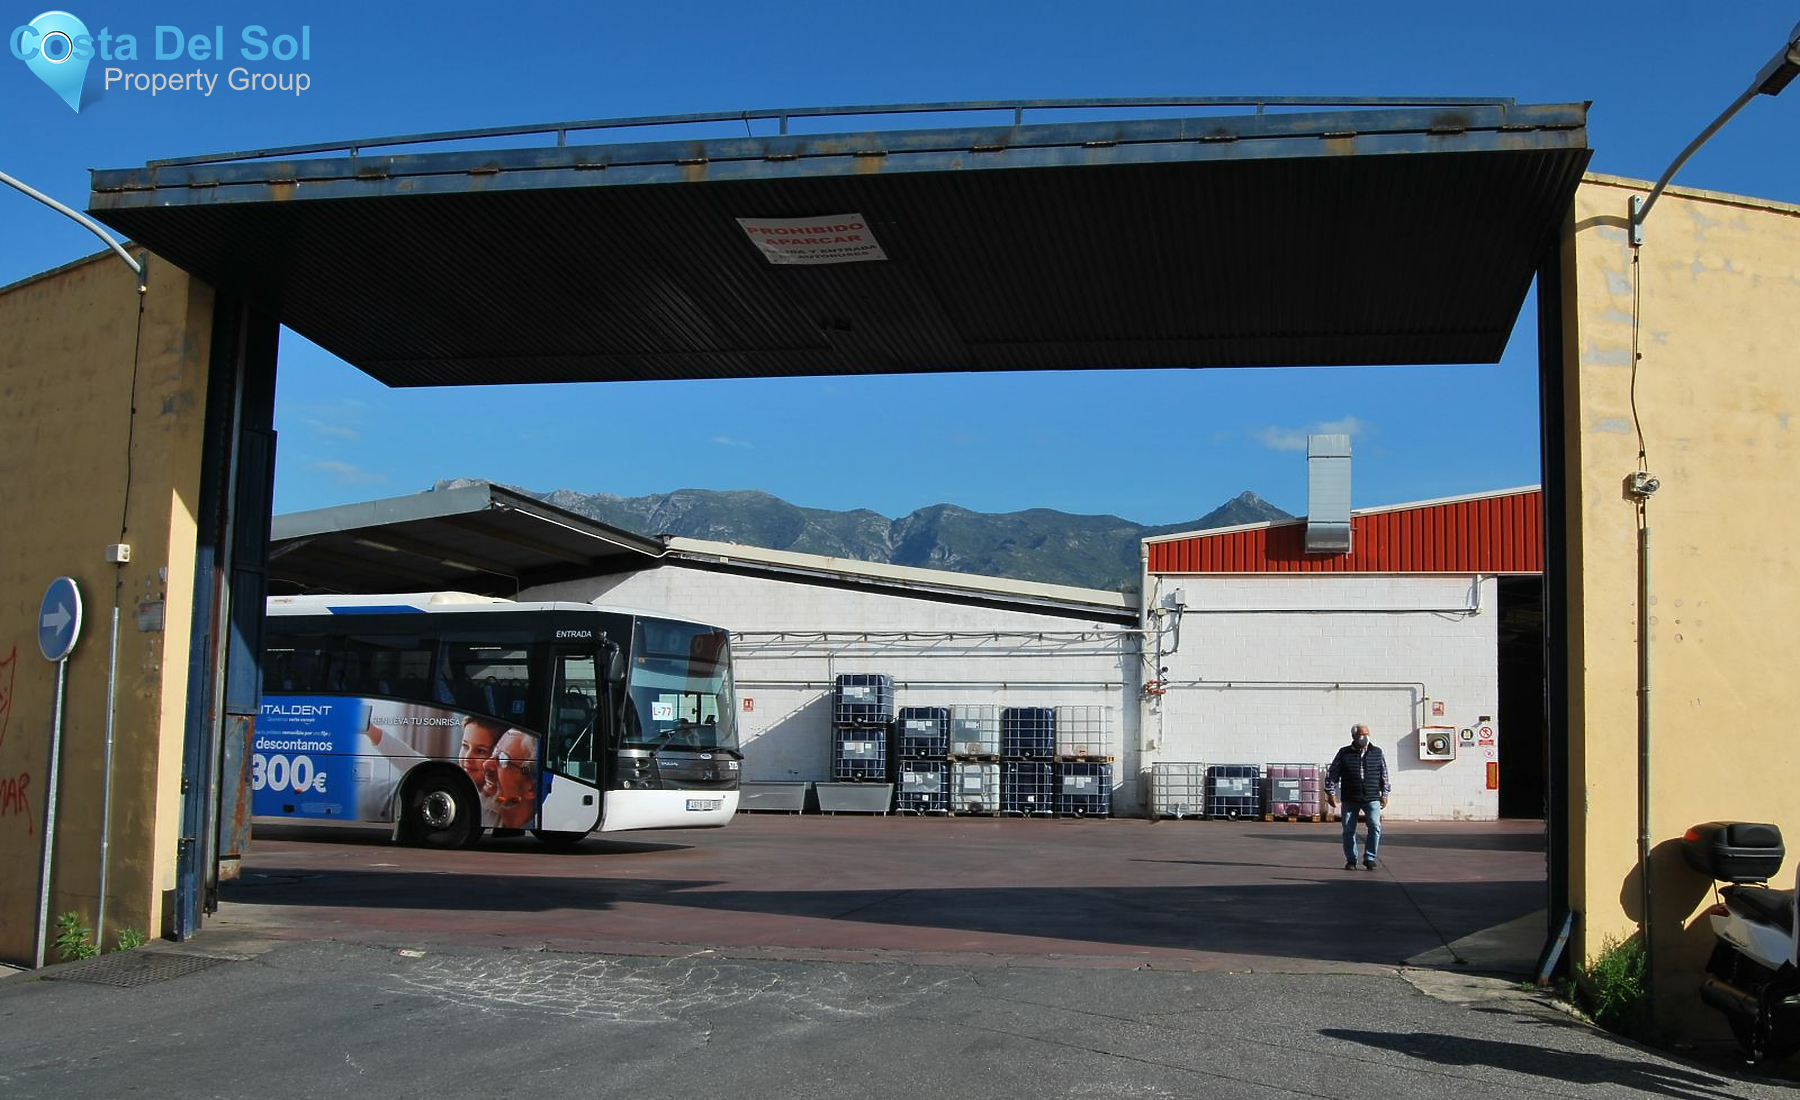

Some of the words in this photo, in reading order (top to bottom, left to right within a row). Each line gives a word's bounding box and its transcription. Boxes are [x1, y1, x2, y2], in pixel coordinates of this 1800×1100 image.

[747, 222, 864, 236] PROHIBIDO
[765, 235, 863, 246] APARCAR
[556, 630, 592, 638] ENTRADA
[653, 706, 672, 717] L-77
[411, 717, 422, 726] TU
[423, 717, 461, 726] SONRISA
[256, 736, 333, 752] descontamos
